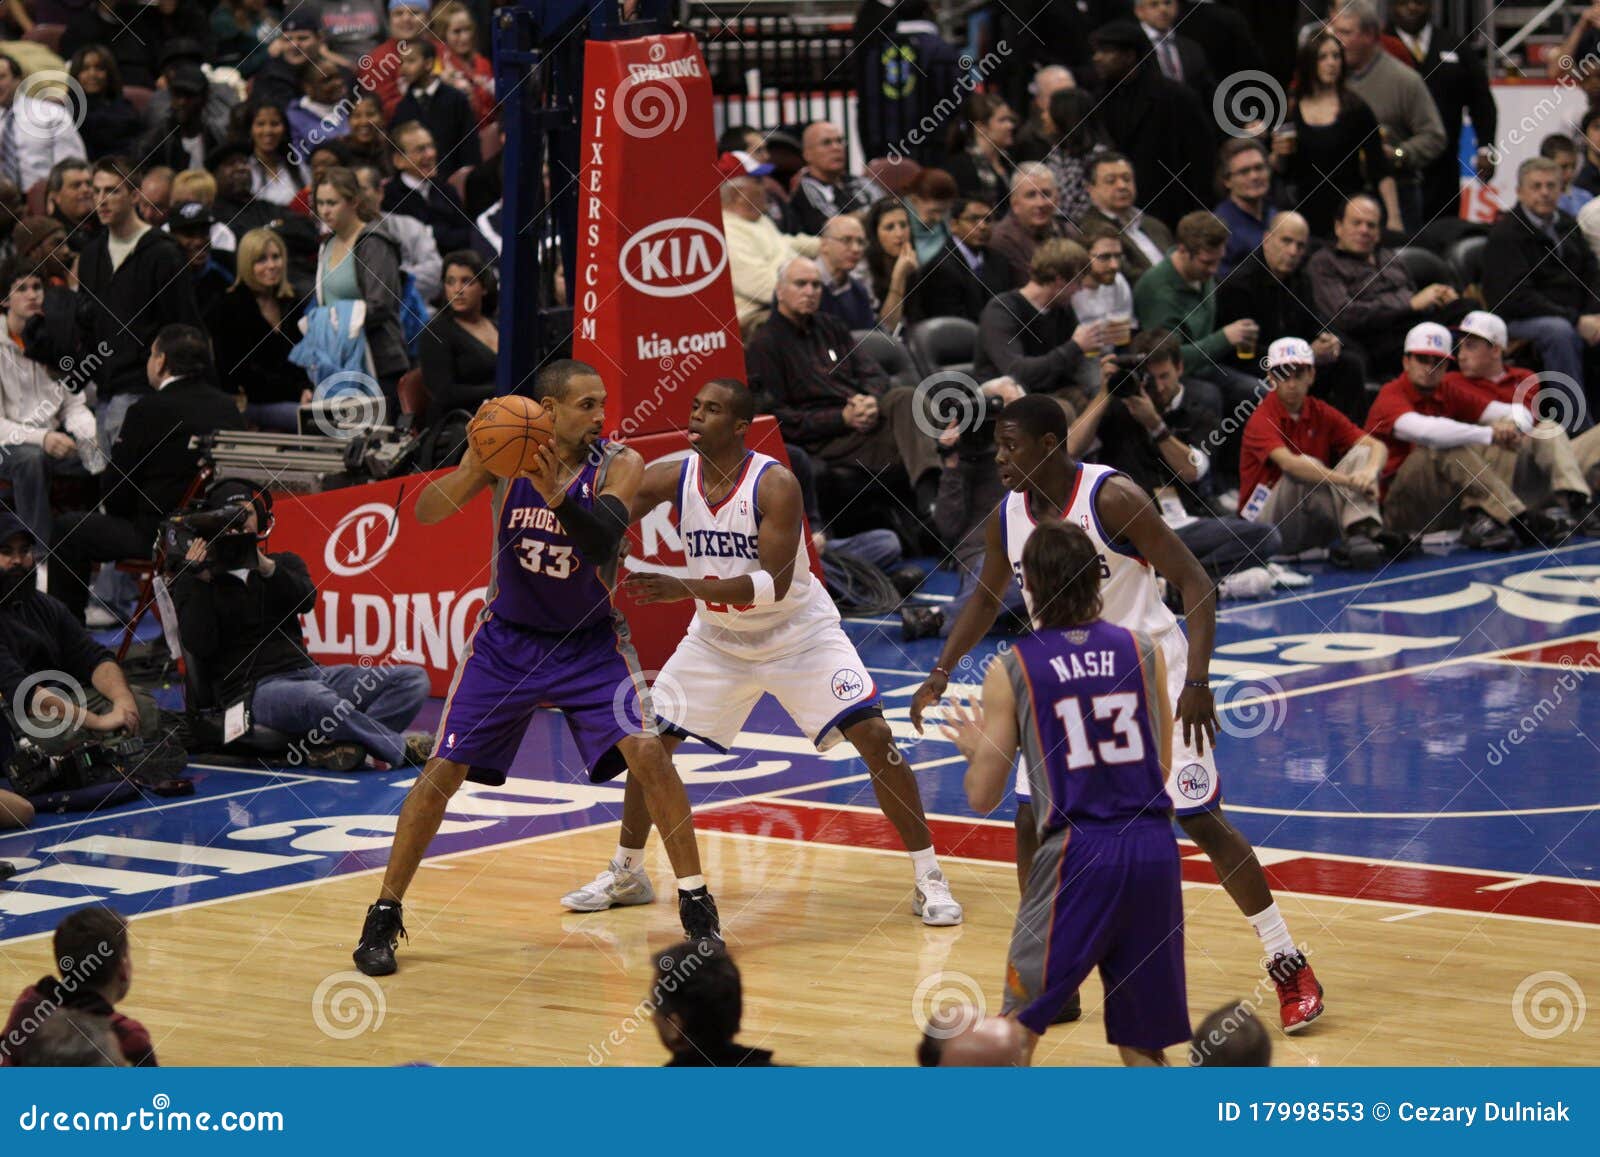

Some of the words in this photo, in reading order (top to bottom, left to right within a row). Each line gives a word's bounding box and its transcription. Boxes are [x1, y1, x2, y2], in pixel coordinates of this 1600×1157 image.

[628, 56, 701, 85] SPALDING
[639, 234, 713, 281] KIA
[637, 330, 727, 360] kia.com
[519, 537, 573, 579] 33
[1050, 651, 1115, 682] NASH
[1054, 692, 1145, 770] 13
